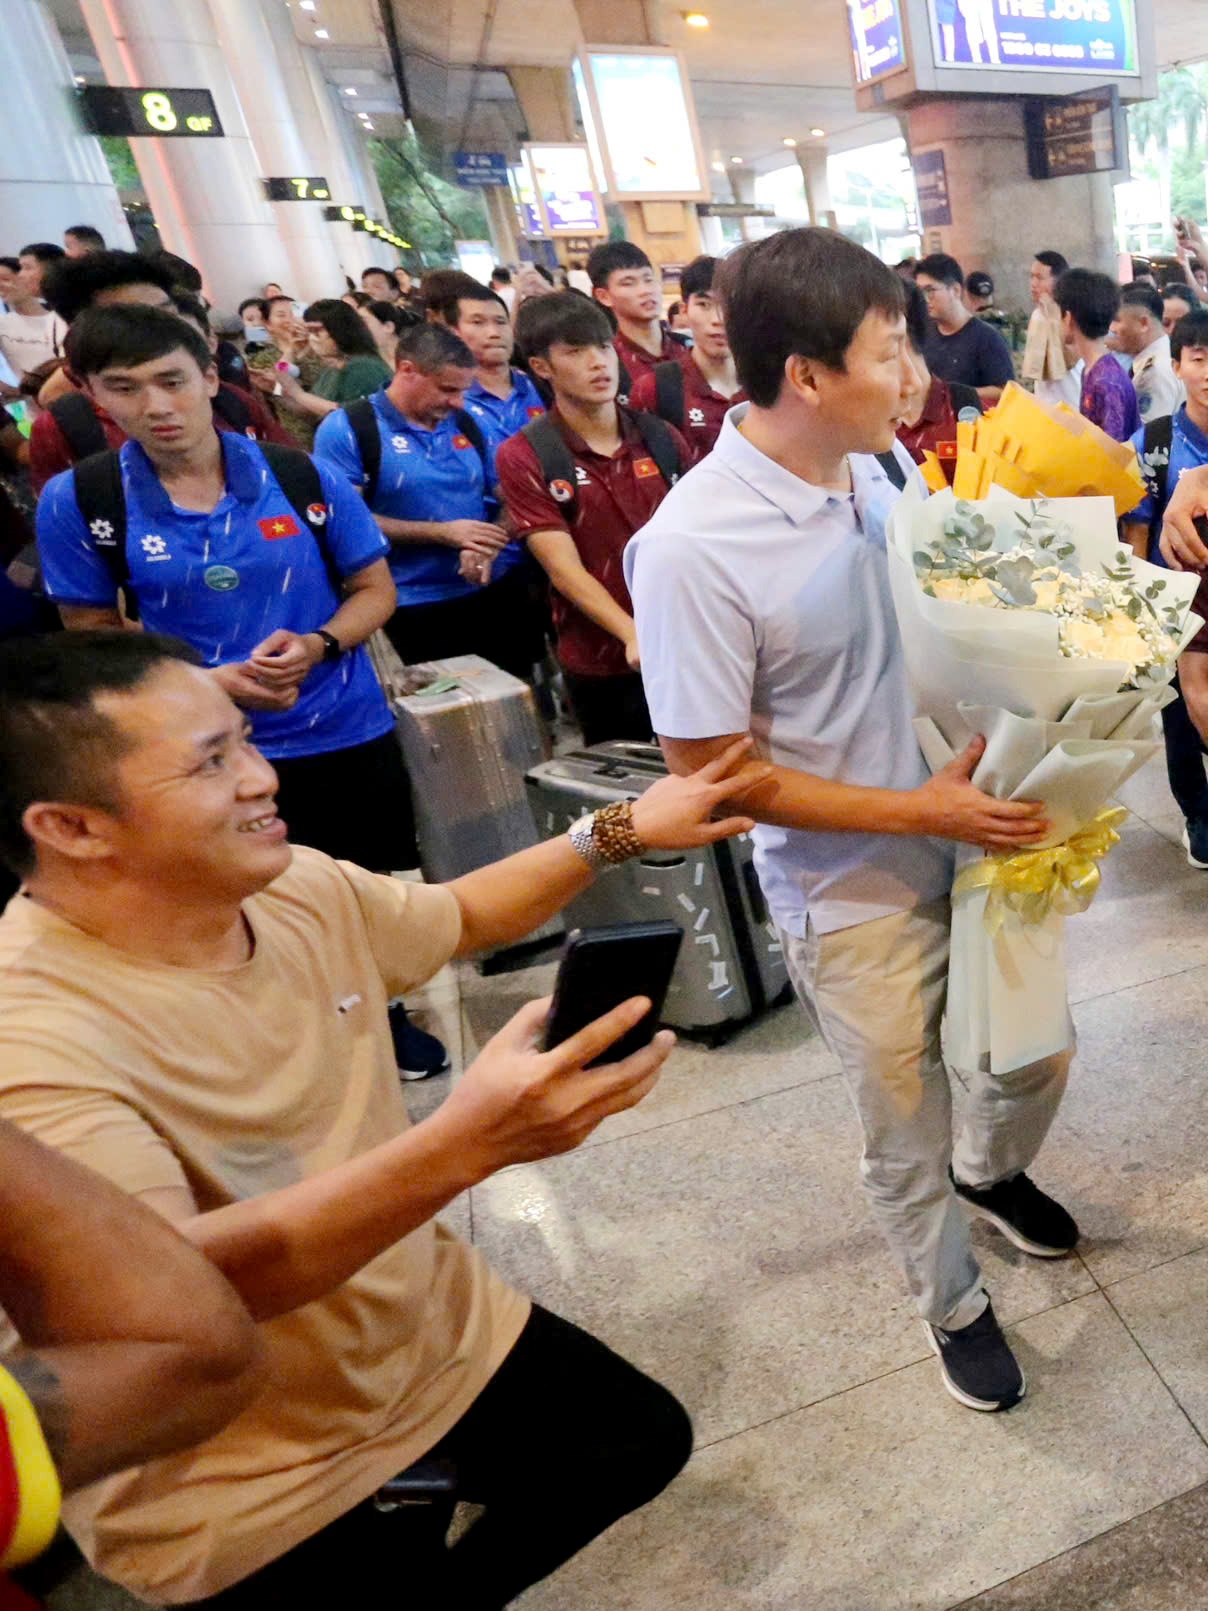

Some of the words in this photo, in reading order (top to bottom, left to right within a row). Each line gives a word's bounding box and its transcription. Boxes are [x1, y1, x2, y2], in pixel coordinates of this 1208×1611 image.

[999, 0, 1045, 18] THE
[1050, 0, 1112, 22] JOYS
[142, 92, 177, 131] 8
[291, 178, 309, 198] 7
